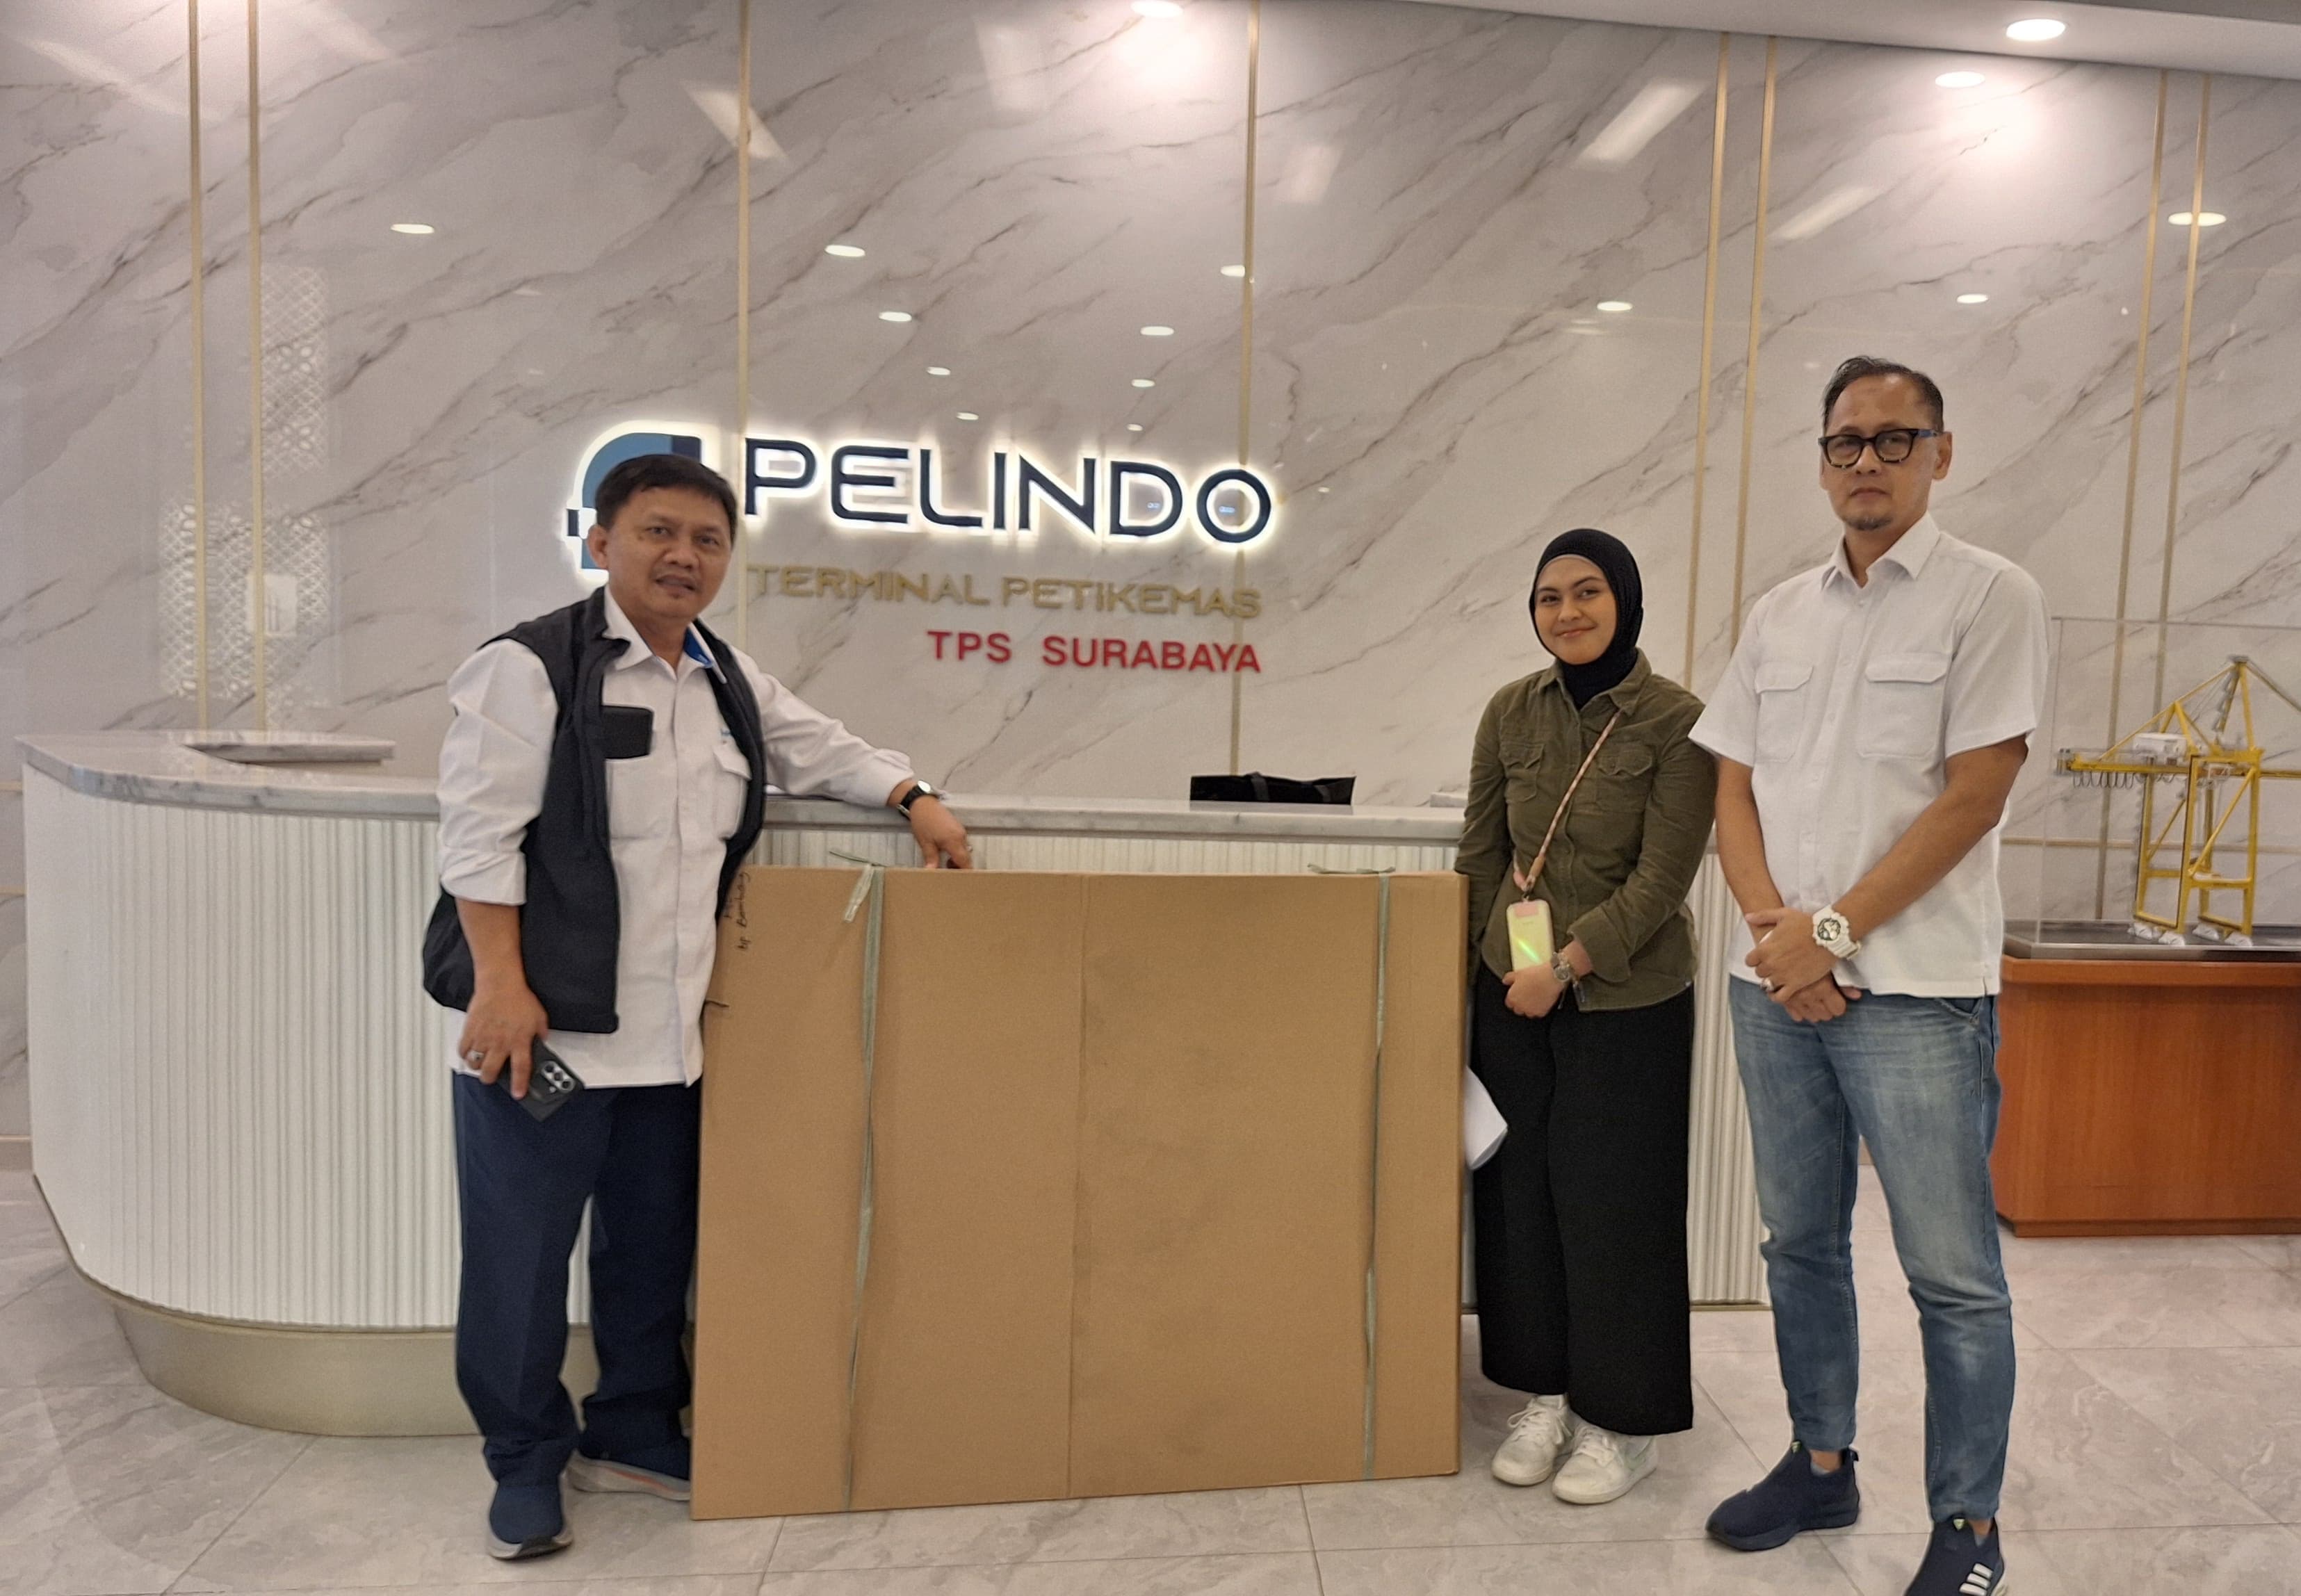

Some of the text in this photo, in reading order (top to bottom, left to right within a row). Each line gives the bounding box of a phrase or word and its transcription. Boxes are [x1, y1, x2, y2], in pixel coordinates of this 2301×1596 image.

[745, 437, 1272, 544] PELINDO
[747, 564, 1262, 619] TERMINAL PETIKEMAS
[927, 630, 1262, 673] TPS SURABAYA
